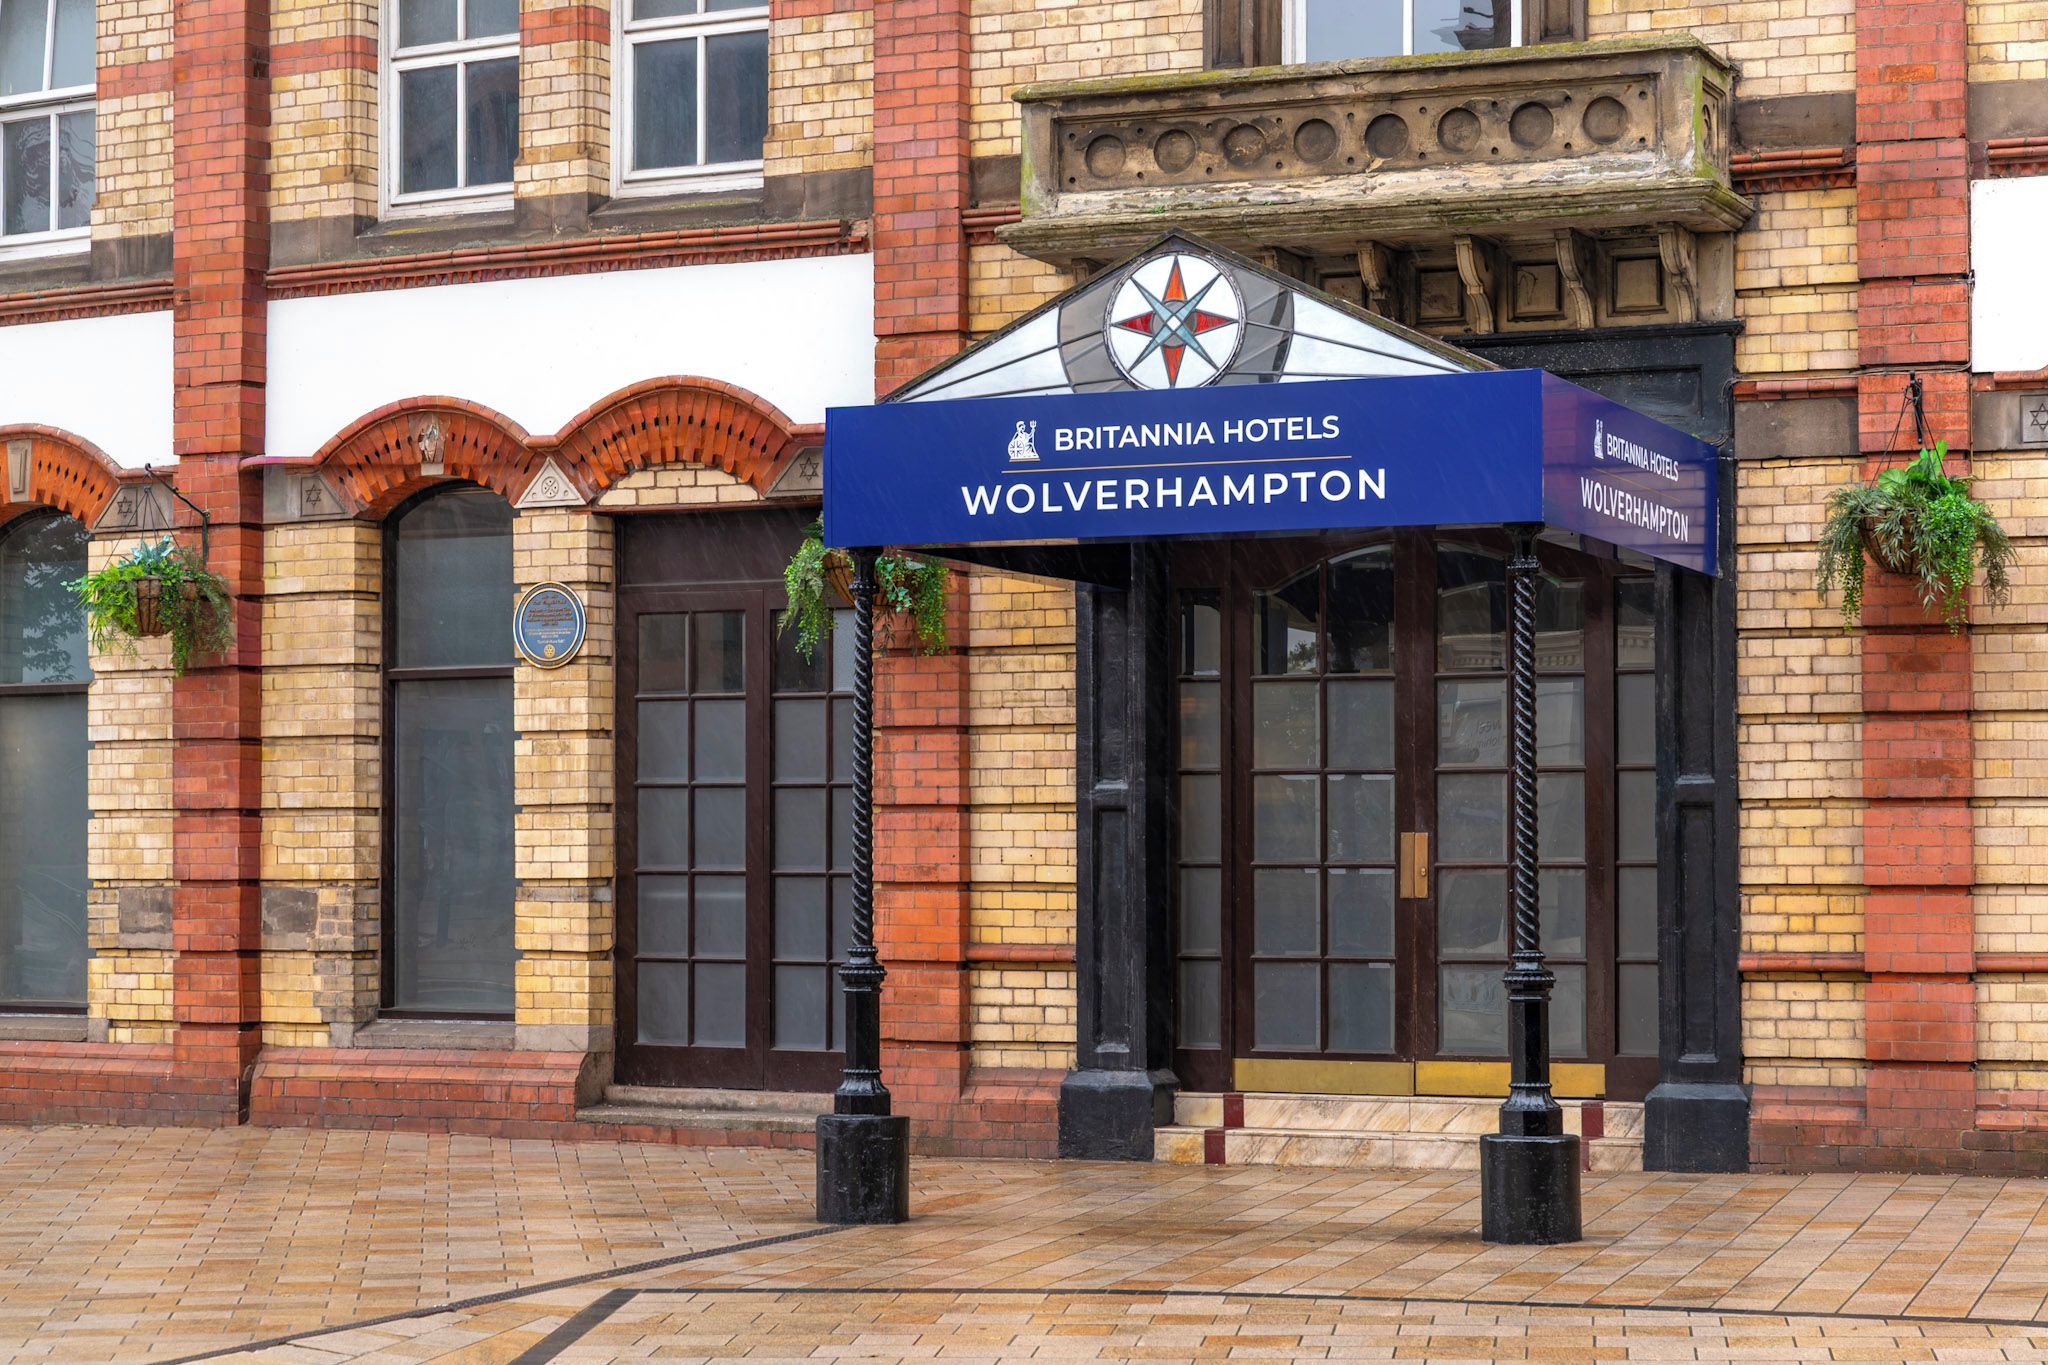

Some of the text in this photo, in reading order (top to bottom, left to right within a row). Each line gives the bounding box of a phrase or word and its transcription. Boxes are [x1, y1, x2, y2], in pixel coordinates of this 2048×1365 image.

[1055, 415, 1340, 451] BRITANNIA HOTELS
[1607, 434, 1679, 481] BRITANNIA HOTELS
[961, 468, 1387, 515] WOLVERHAMPTON
[1580, 477, 1689, 542] WOLVERHAMPTON
